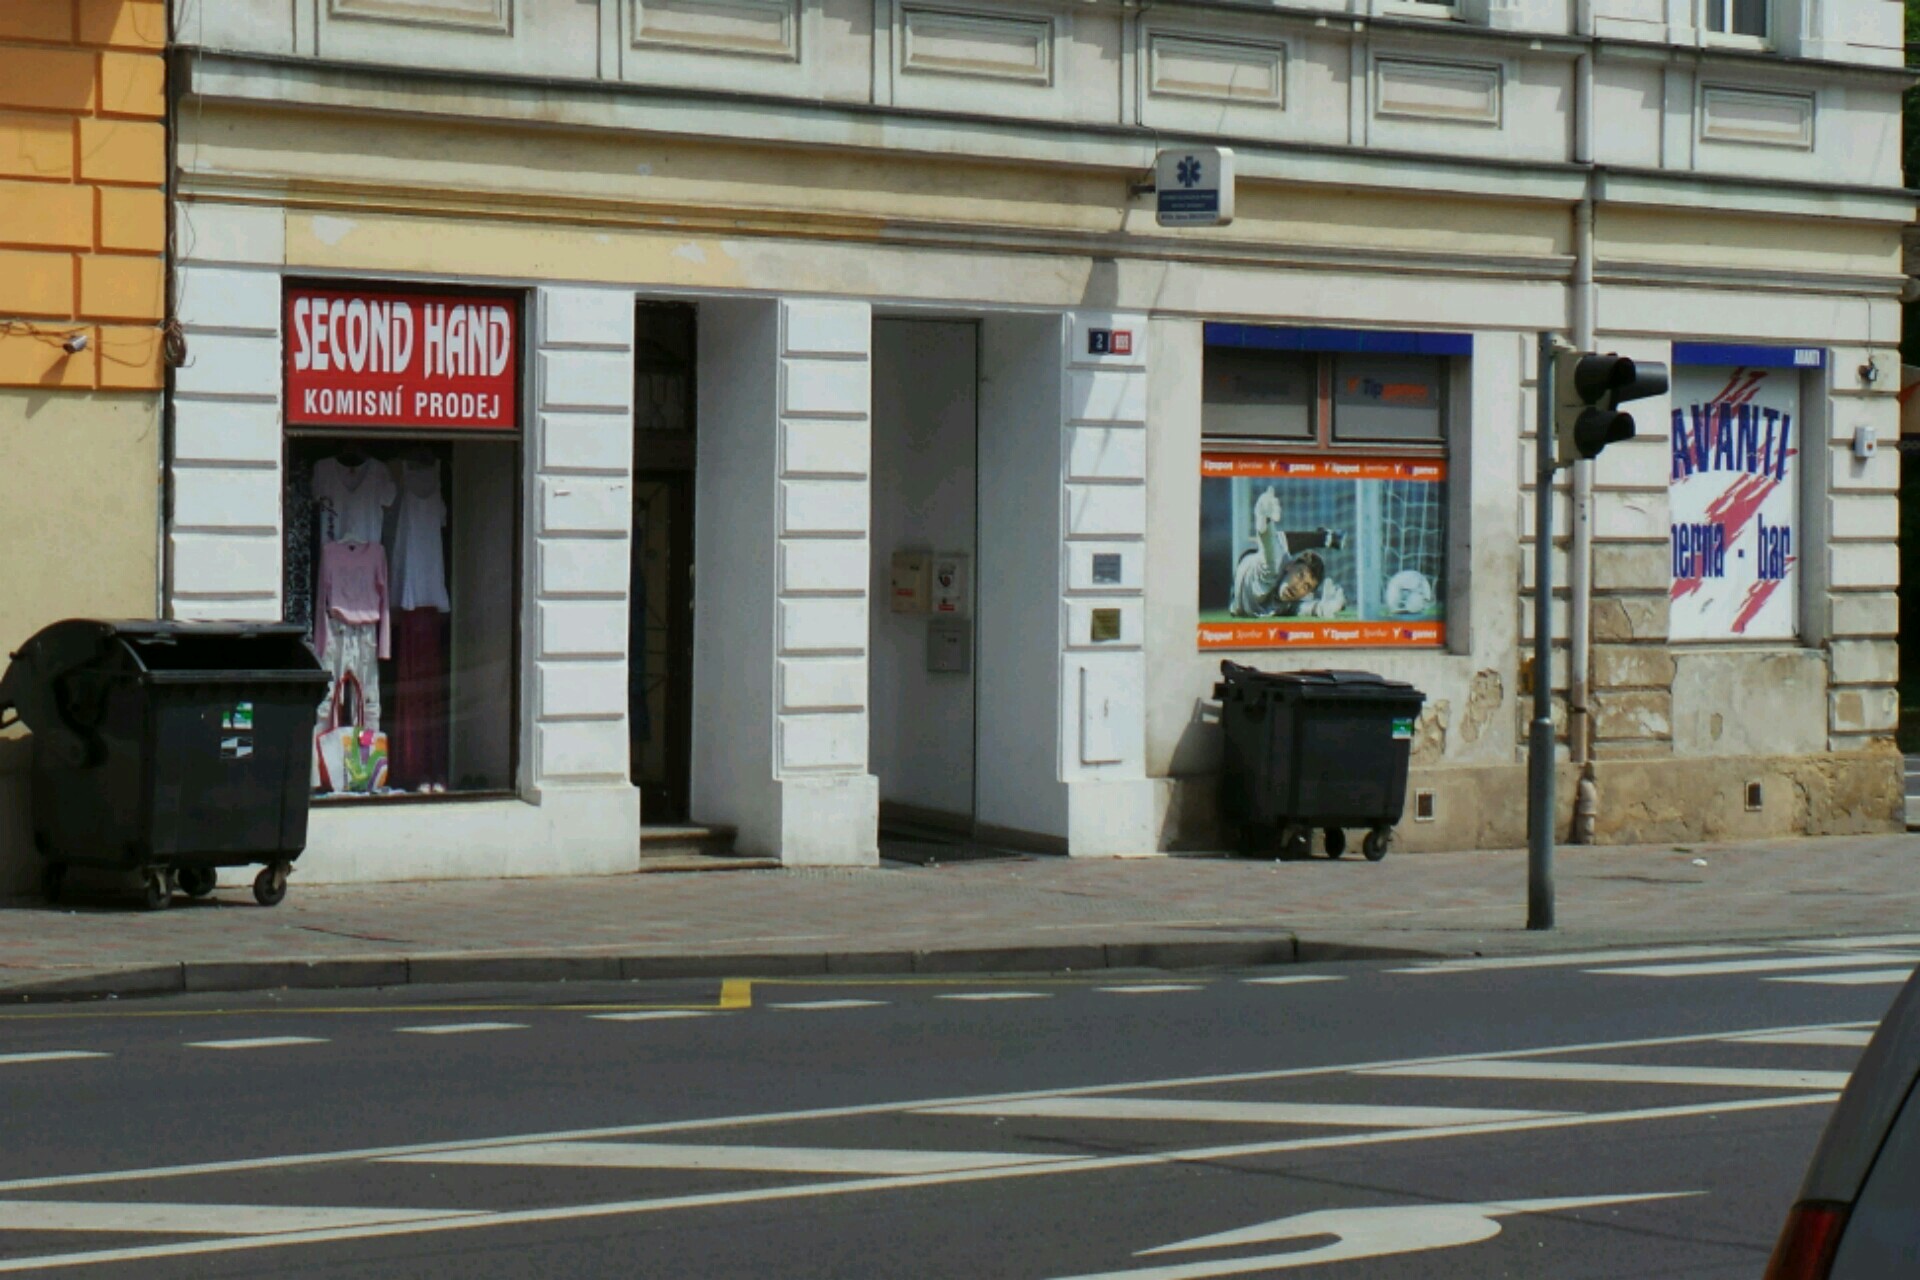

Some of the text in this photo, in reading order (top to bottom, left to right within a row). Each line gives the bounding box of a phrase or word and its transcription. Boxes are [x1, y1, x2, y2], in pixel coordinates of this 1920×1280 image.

[294, 297, 511, 380] SECOND HAND
[304, 385, 500, 419] KOMISNÍ PRODEJ
[1671, 402, 1790, 481] AVANTI
[1758, 513, 1790, 579] bar
